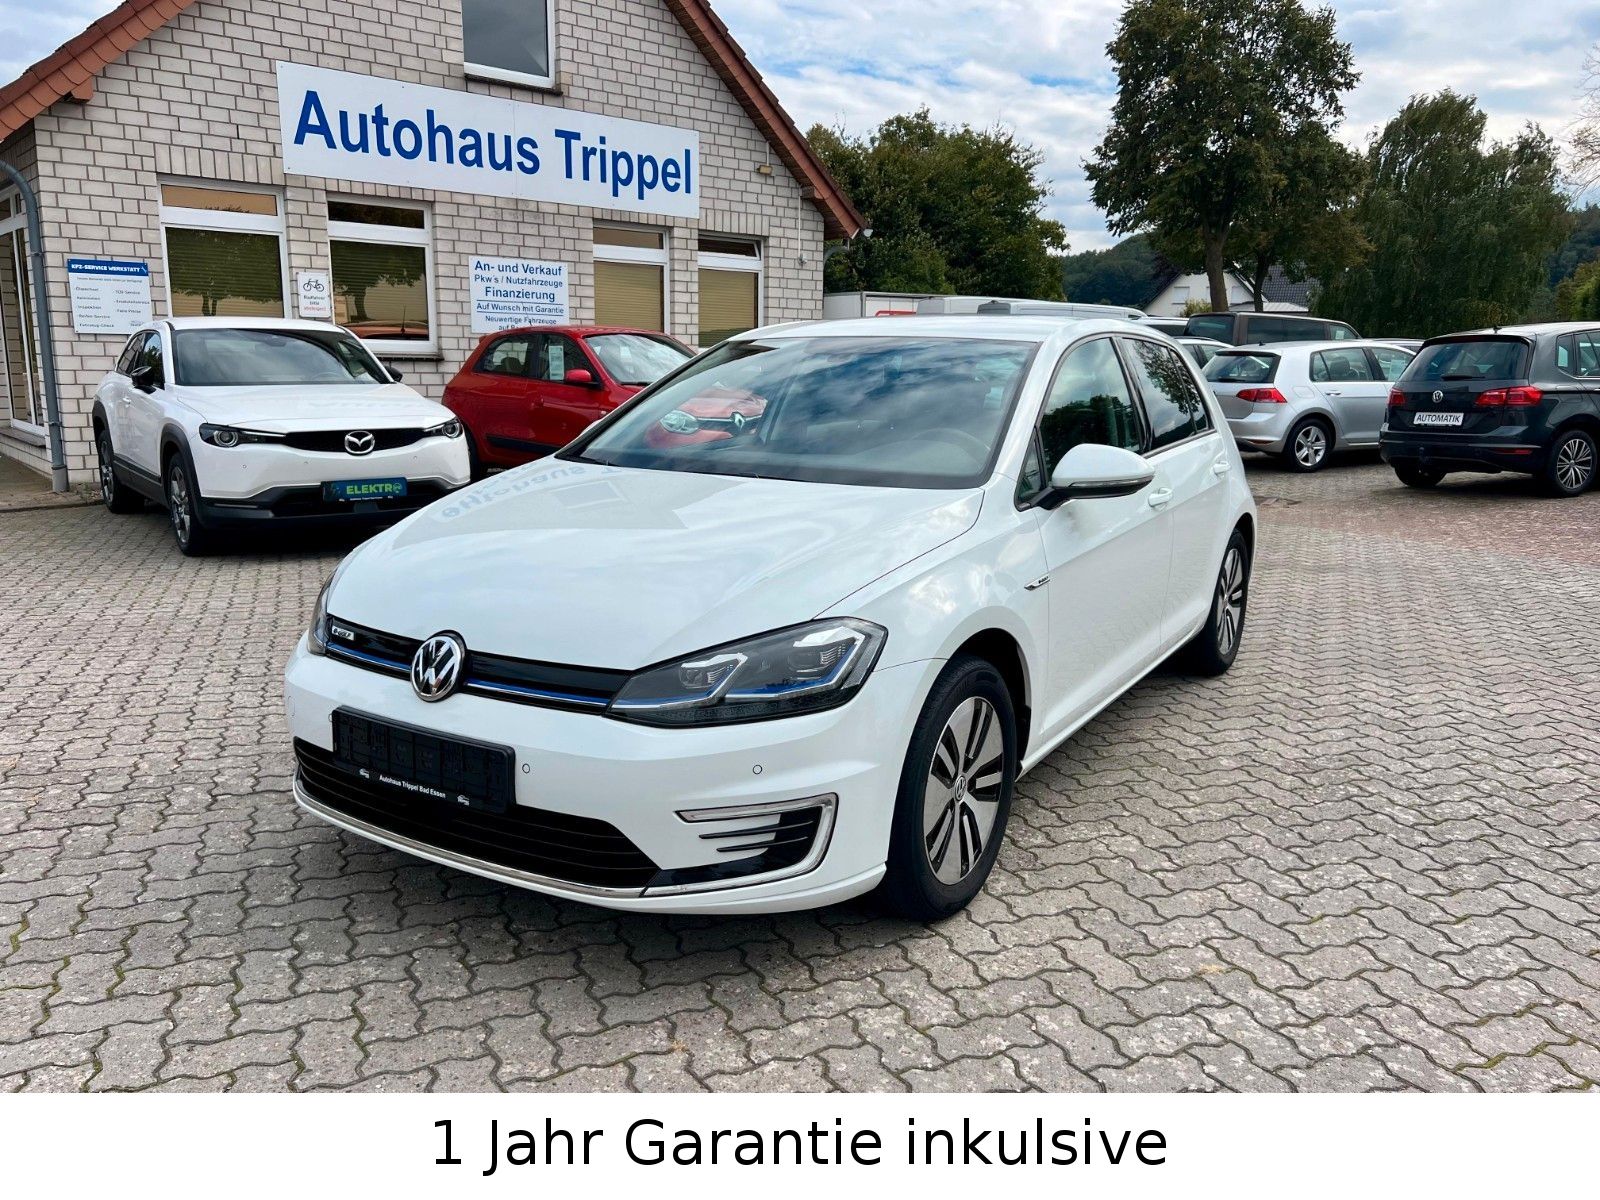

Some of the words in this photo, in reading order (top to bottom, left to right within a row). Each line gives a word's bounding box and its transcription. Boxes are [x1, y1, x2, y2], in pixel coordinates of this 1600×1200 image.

[294, 90, 540, 175] Autohaus
[554, 129, 691, 200] Trippel
[475, 260, 495, 272] An-
[498, 263, 519, 273] und
[522, 263, 562, 276] Verkauf
[506, 277, 563, 288] Nutzfahrzeuge
[485, 287, 555, 302] Finanzierung
[476, 302, 490, 310] Auf
[491, 303, 520, 312] Wunsch
[522, 305, 534, 313] mit
[535, 305, 564, 314] Garantie
[485, 315, 522, 325] Neuwertige
[524, 316, 557, 325] Fahrzeuge
[1416, 414, 1461, 423] AUTOMATIK
[380, 774, 402, 787] Autohaus
[402, 781, 419, 792] Trippel
[419, 786, 430, 794] Bad
[430, 788, 446, 799] Essen
